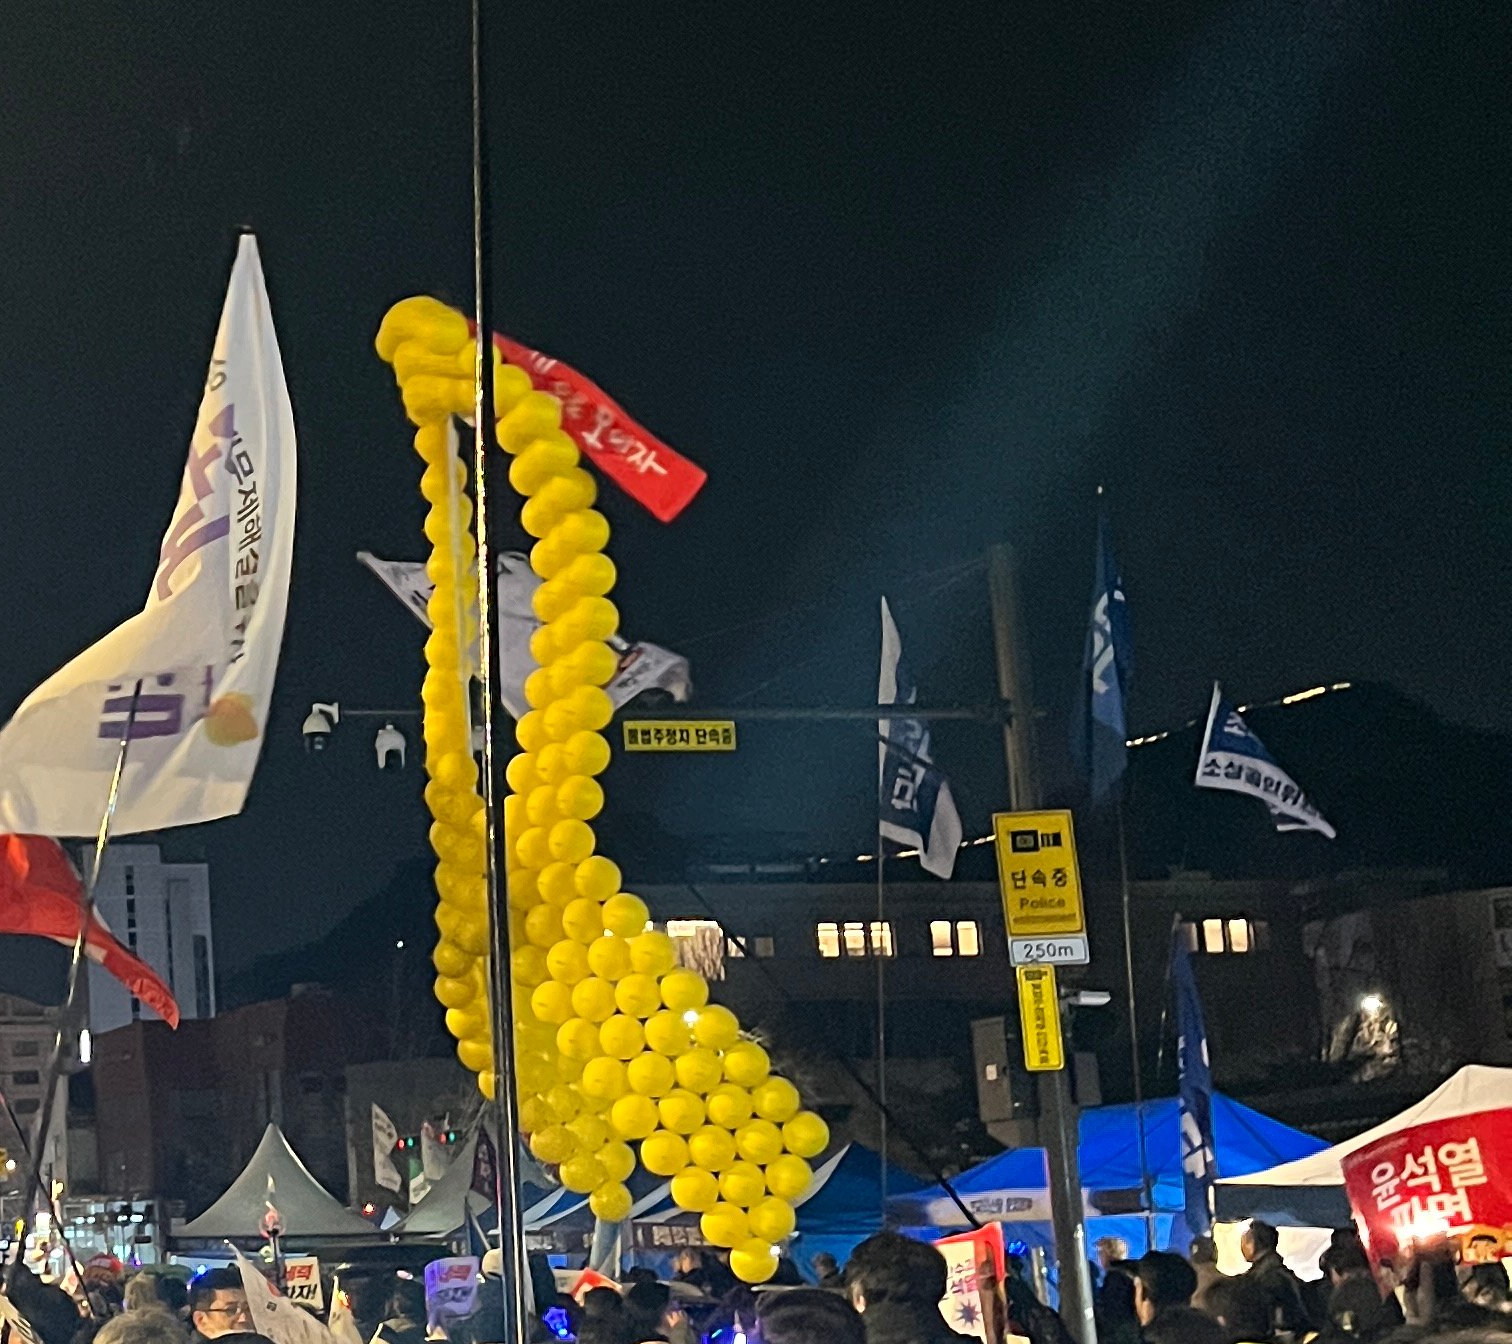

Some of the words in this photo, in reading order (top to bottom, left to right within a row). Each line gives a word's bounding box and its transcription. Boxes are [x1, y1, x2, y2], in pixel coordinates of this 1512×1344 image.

[1011, 867, 1068, 890] 단속중
[1023, 942, 1074, 959] 250m
[1371, 1137, 1488, 1213] 윤석열
